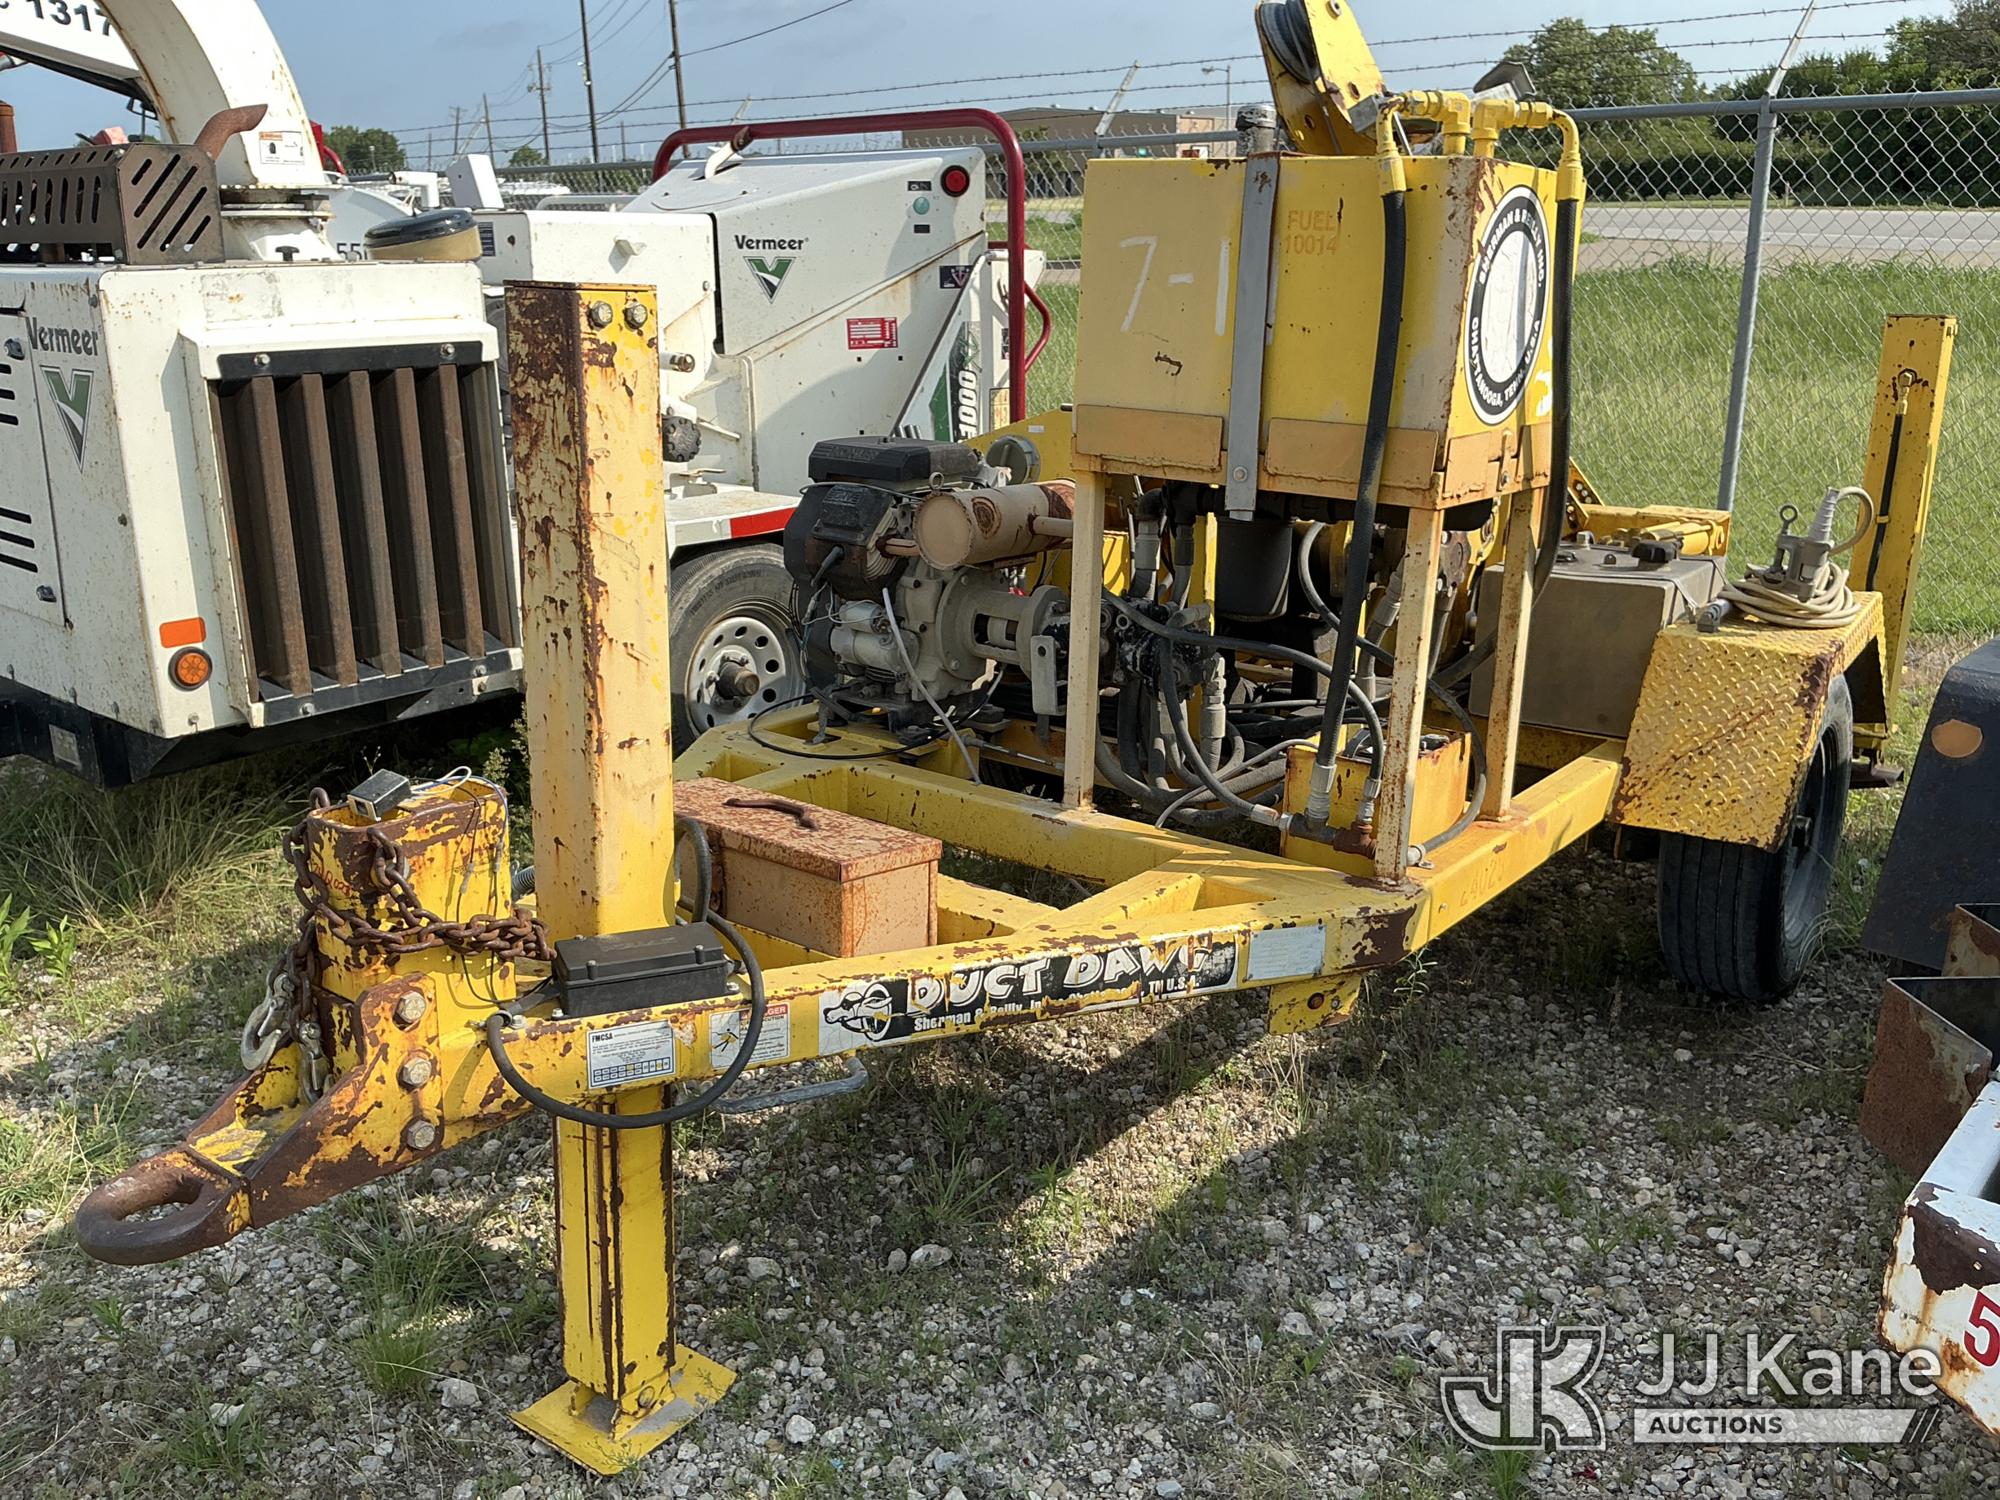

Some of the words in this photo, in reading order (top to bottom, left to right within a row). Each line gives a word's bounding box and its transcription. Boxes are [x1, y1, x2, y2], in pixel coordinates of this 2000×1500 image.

[1287, 210, 1337, 231] FUEL
[734, 234, 804, 251] Vermeer
[1285, 234, 1337, 255] 10014
[1479, 210, 1514, 284] SHERMAN
[1514, 208, 1521, 222] &
[25, 316, 99, 356] Vermeer
[907, 958, 1051, 1017] DUCT
[914, 1011, 971, 1031] Sherman
[592, 1032, 613, 1043] FMCSA
